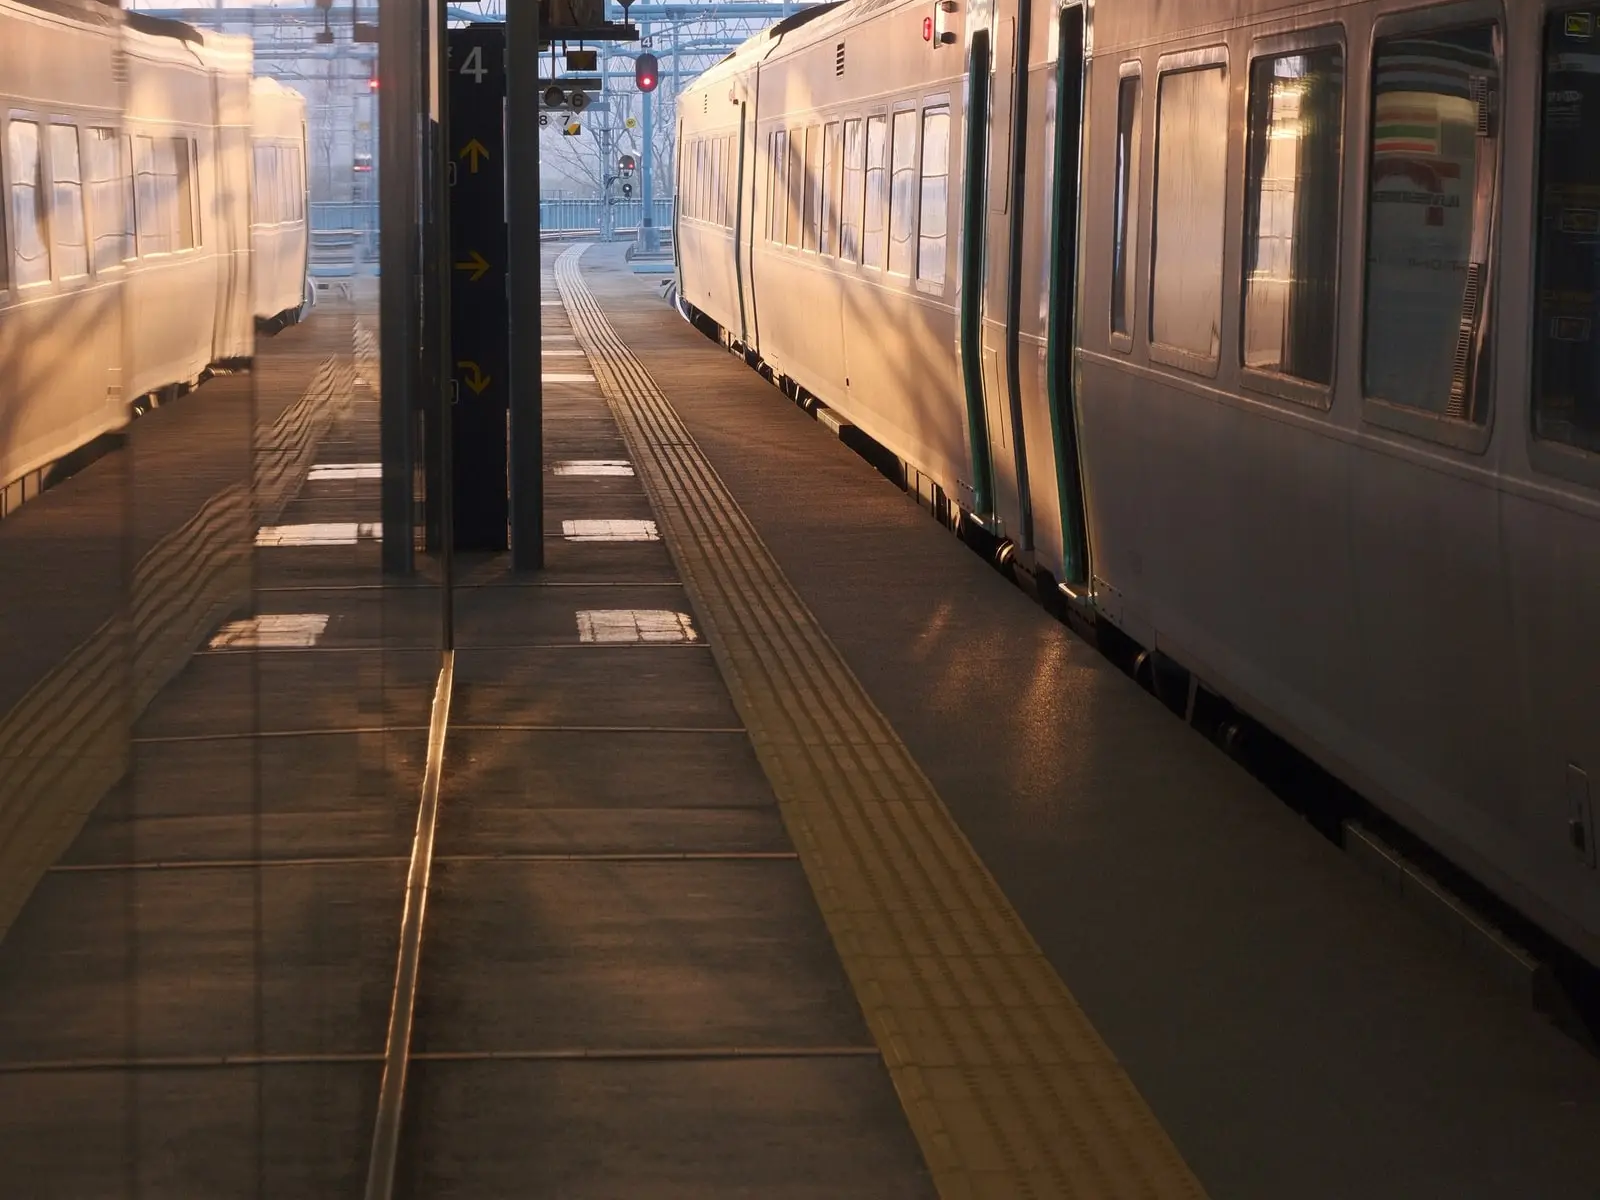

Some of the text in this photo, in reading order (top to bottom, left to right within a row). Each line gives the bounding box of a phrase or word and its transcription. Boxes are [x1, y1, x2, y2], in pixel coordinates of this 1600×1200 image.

[641, 38, 652, 47] 4
[459, 46, 489, 84] 4
[572, 93, 584, 107] 6
[539, 115, 548, 126] 8
[561, 115, 571, 126] 7
